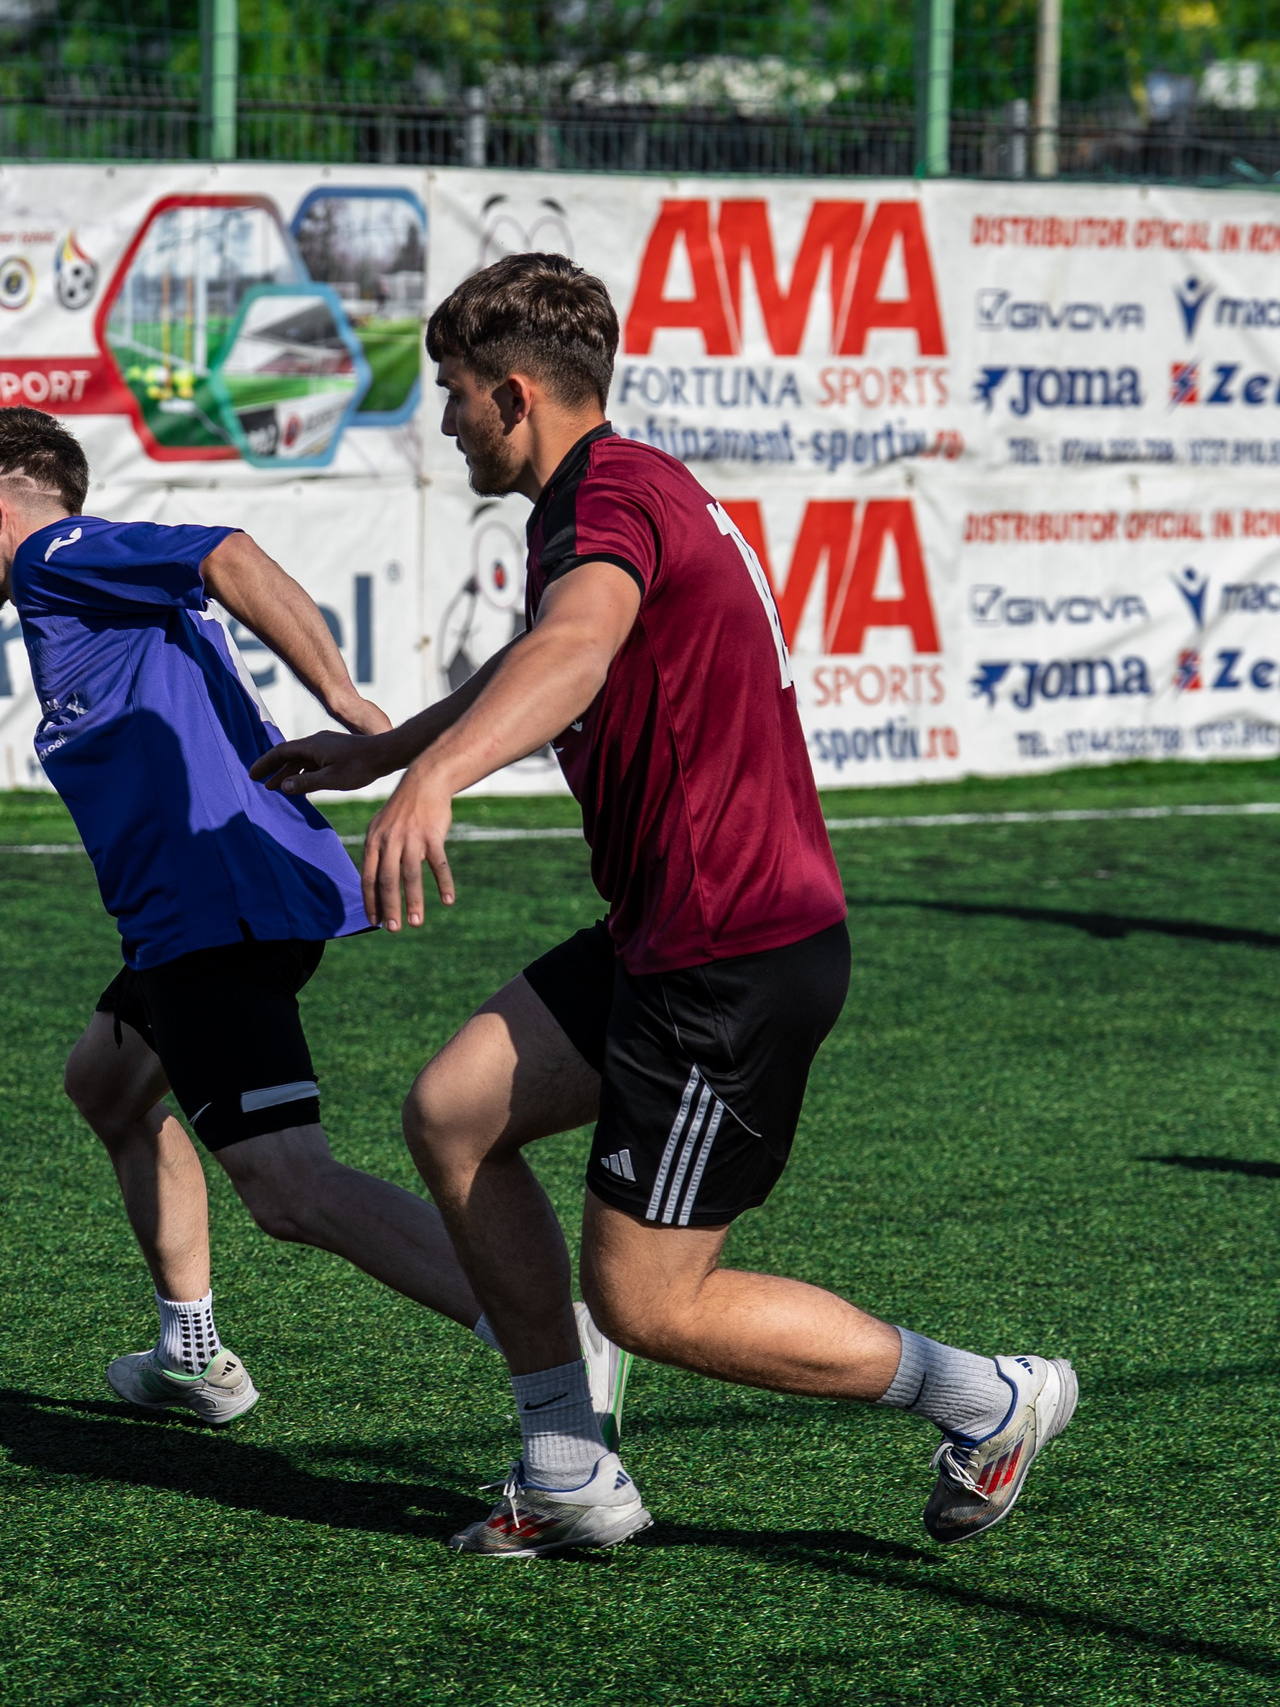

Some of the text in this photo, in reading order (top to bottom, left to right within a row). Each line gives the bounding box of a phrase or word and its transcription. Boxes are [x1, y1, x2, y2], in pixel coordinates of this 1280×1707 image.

[623, 196, 949, 358] AMA
[1007, 300, 1146, 332] GIVOVA
[619, 366, 951, 408] FORTUNA SPORTS
[716, 497, 942, 657] MA
[1002, 595, 1151, 626] GIVOVA
[813, 663, 946, 708] SPORTS
